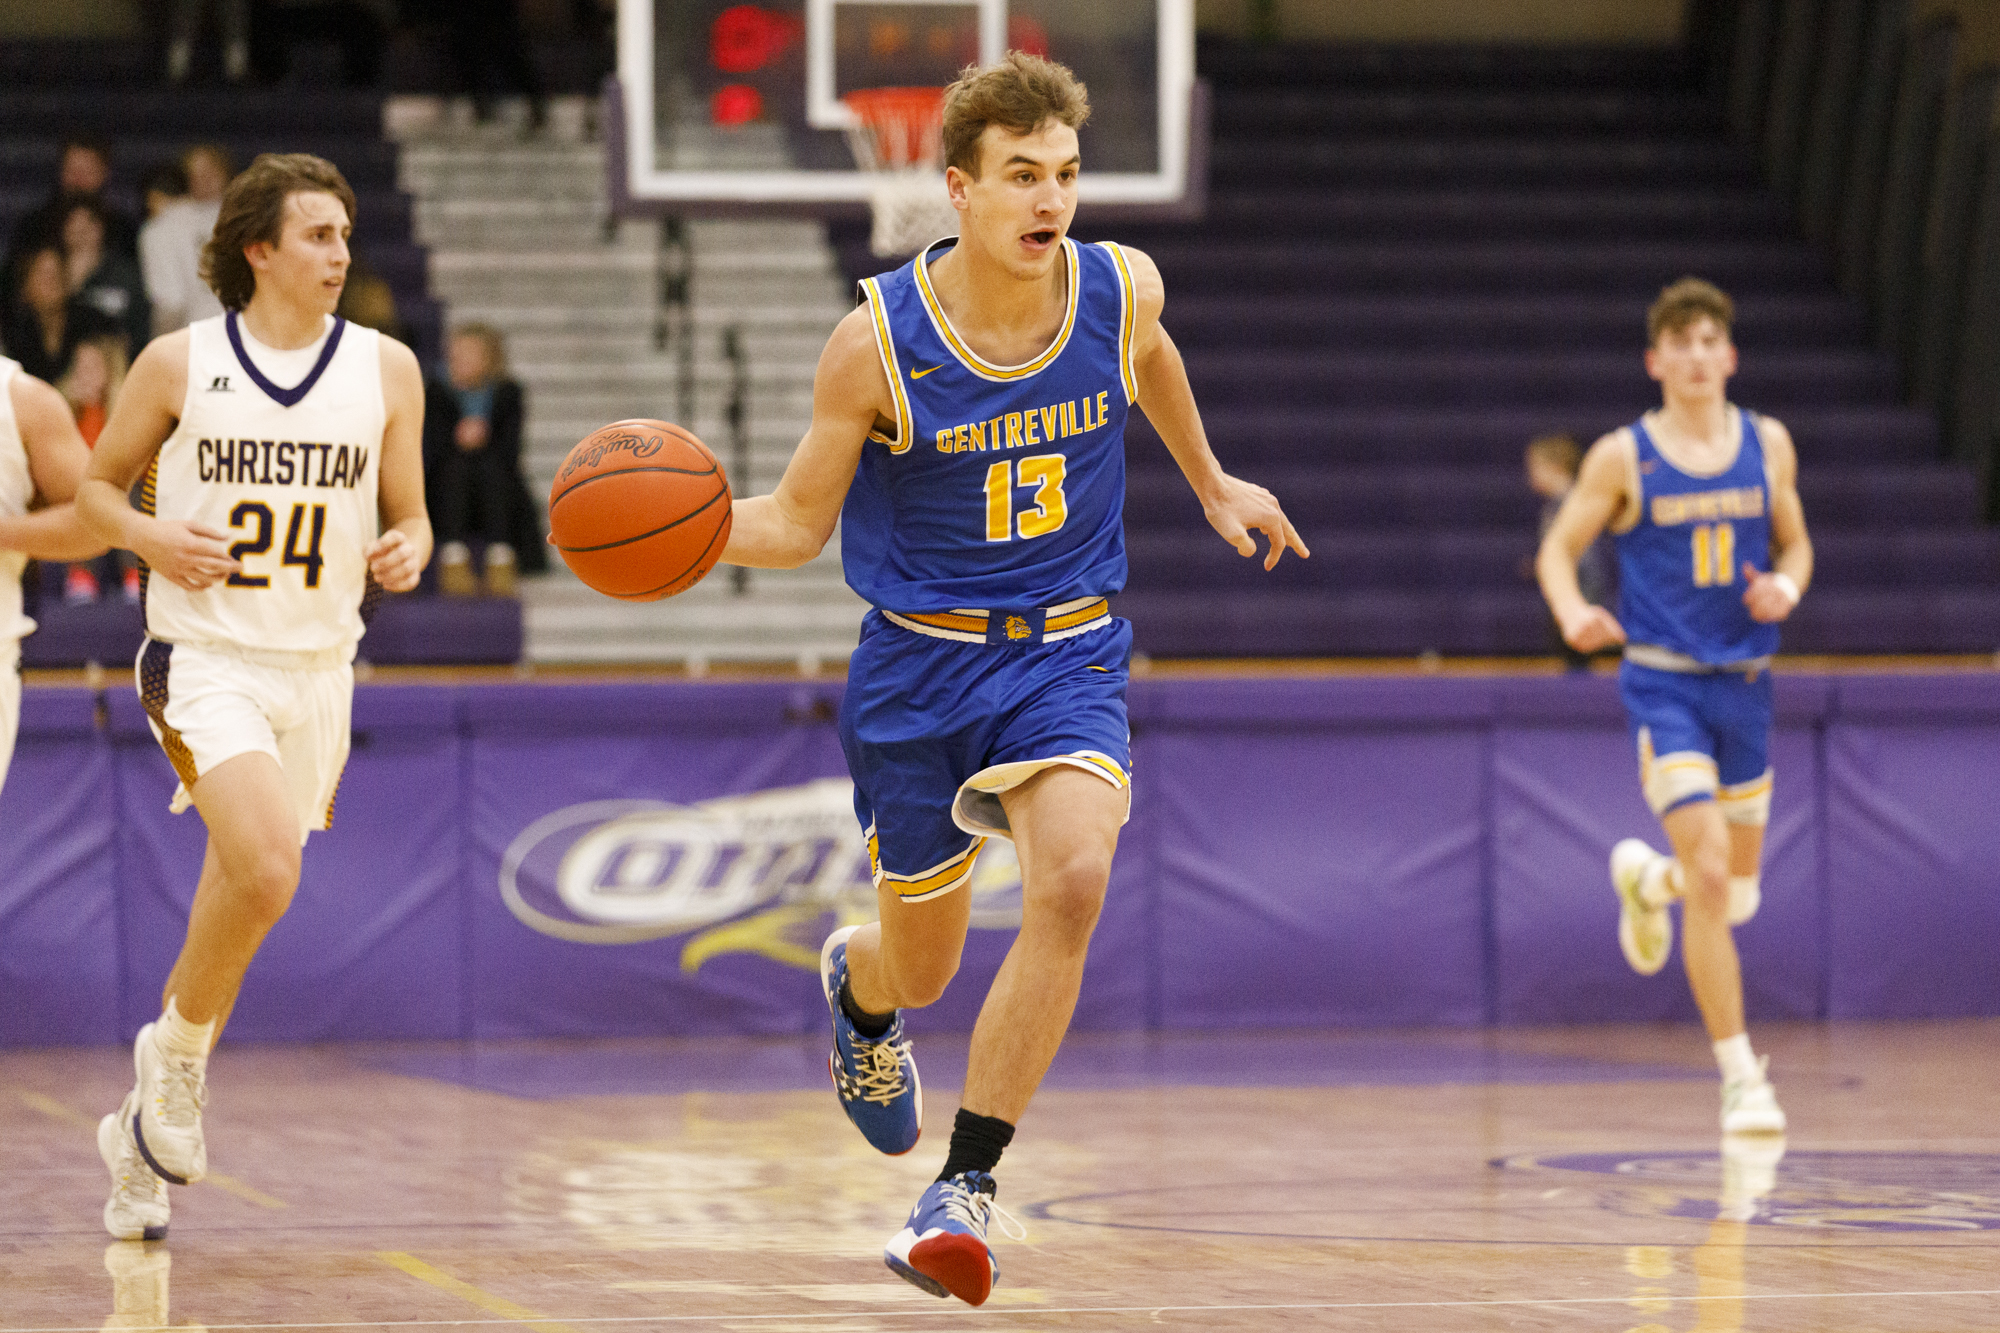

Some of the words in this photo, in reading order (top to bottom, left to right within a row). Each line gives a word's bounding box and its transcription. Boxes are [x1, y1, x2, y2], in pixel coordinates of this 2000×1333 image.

[936, 391, 1109, 454] CENTREVILLE
[198, 439, 369, 489] CHRISTIAN
[562, 432, 664, 482] Rawlings
[983, 453, 1069, 542] 13
[225, 500, 327, 589] 24
[1692, 524, 1735, 588] 11
